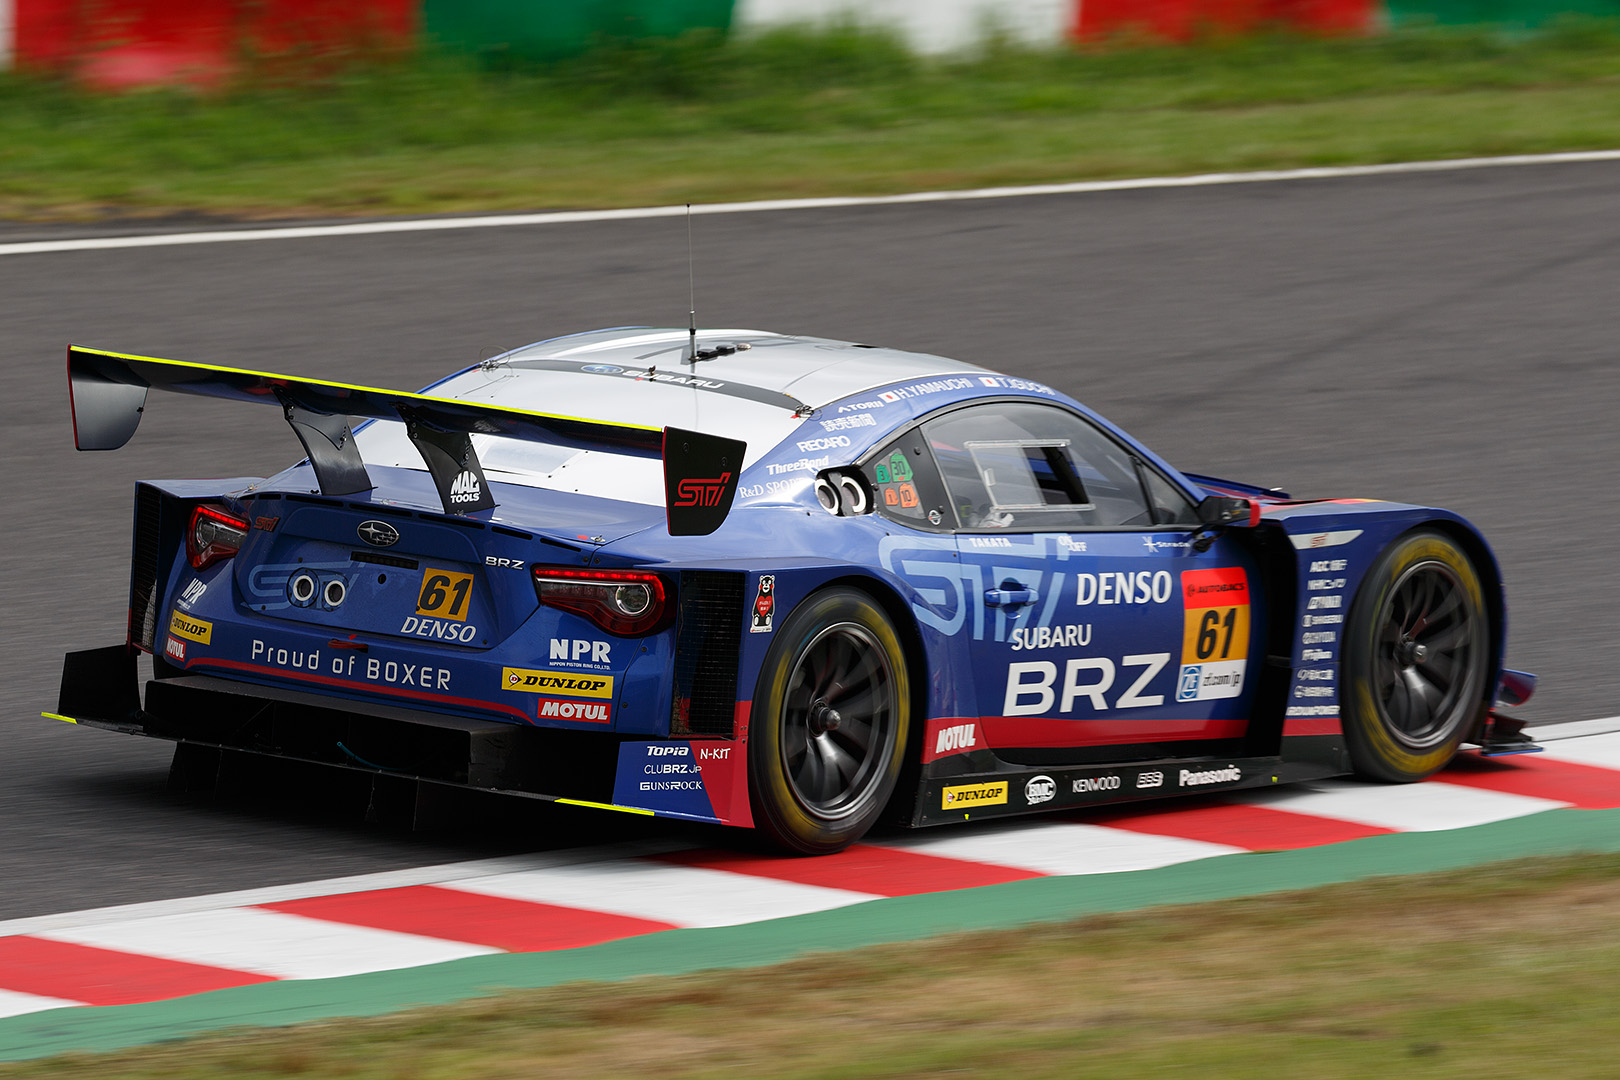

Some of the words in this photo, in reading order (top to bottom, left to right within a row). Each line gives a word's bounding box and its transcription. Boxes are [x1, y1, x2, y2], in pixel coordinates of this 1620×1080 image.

[622, 370, 725, 389] SUBARU
[895, 377, 974, 399] H.YAMAUCHI
[796, 435, 851, 452] RECARO
[766, 455, 829, 476] ThreeBond
[450, 470, 480, 494] MAC
[738, 484, 764, 498] R&D
[450, 492, 480, 504] TOOLS
[968, 537, 1013, 549] TAKATA
[485, 556, 525, 570] BRZ
[419, 574, 472, 616] 61
[1076, 570, 1173, 606] DENSO
[173, 618, 207, 636] DUNLOP
[400, 616, 477, 643] DENSO
[1011, 623, 1093, 651] SUBARU
[1196, 607, 1237, 660] 61
[166, 637, 185, 659] MOTUL
[549, 638, 611, 663] NPR
[251, 639, 320, 671] Proud
[332, 655, 355, 676] of
[366, 658, 452, 691] BOXER
[523, 675, 606, 691] DUNLOP
[1002, 652, 1172, 717] BRZ
[541, 701, 609, 721] MOTUL
[935, 723, 976, 754] MOTUL
[647, 745, 689, 756] Topia
[700, 747, 731, 760] N-KIT
[1072, 775, 1121, 793] KENWOOD
[1178, 764, 1241, 787] Panasonic
[640, 781, 703, 791] GUNSROCK
[955, 788, 1003, 802] DUNLOP
